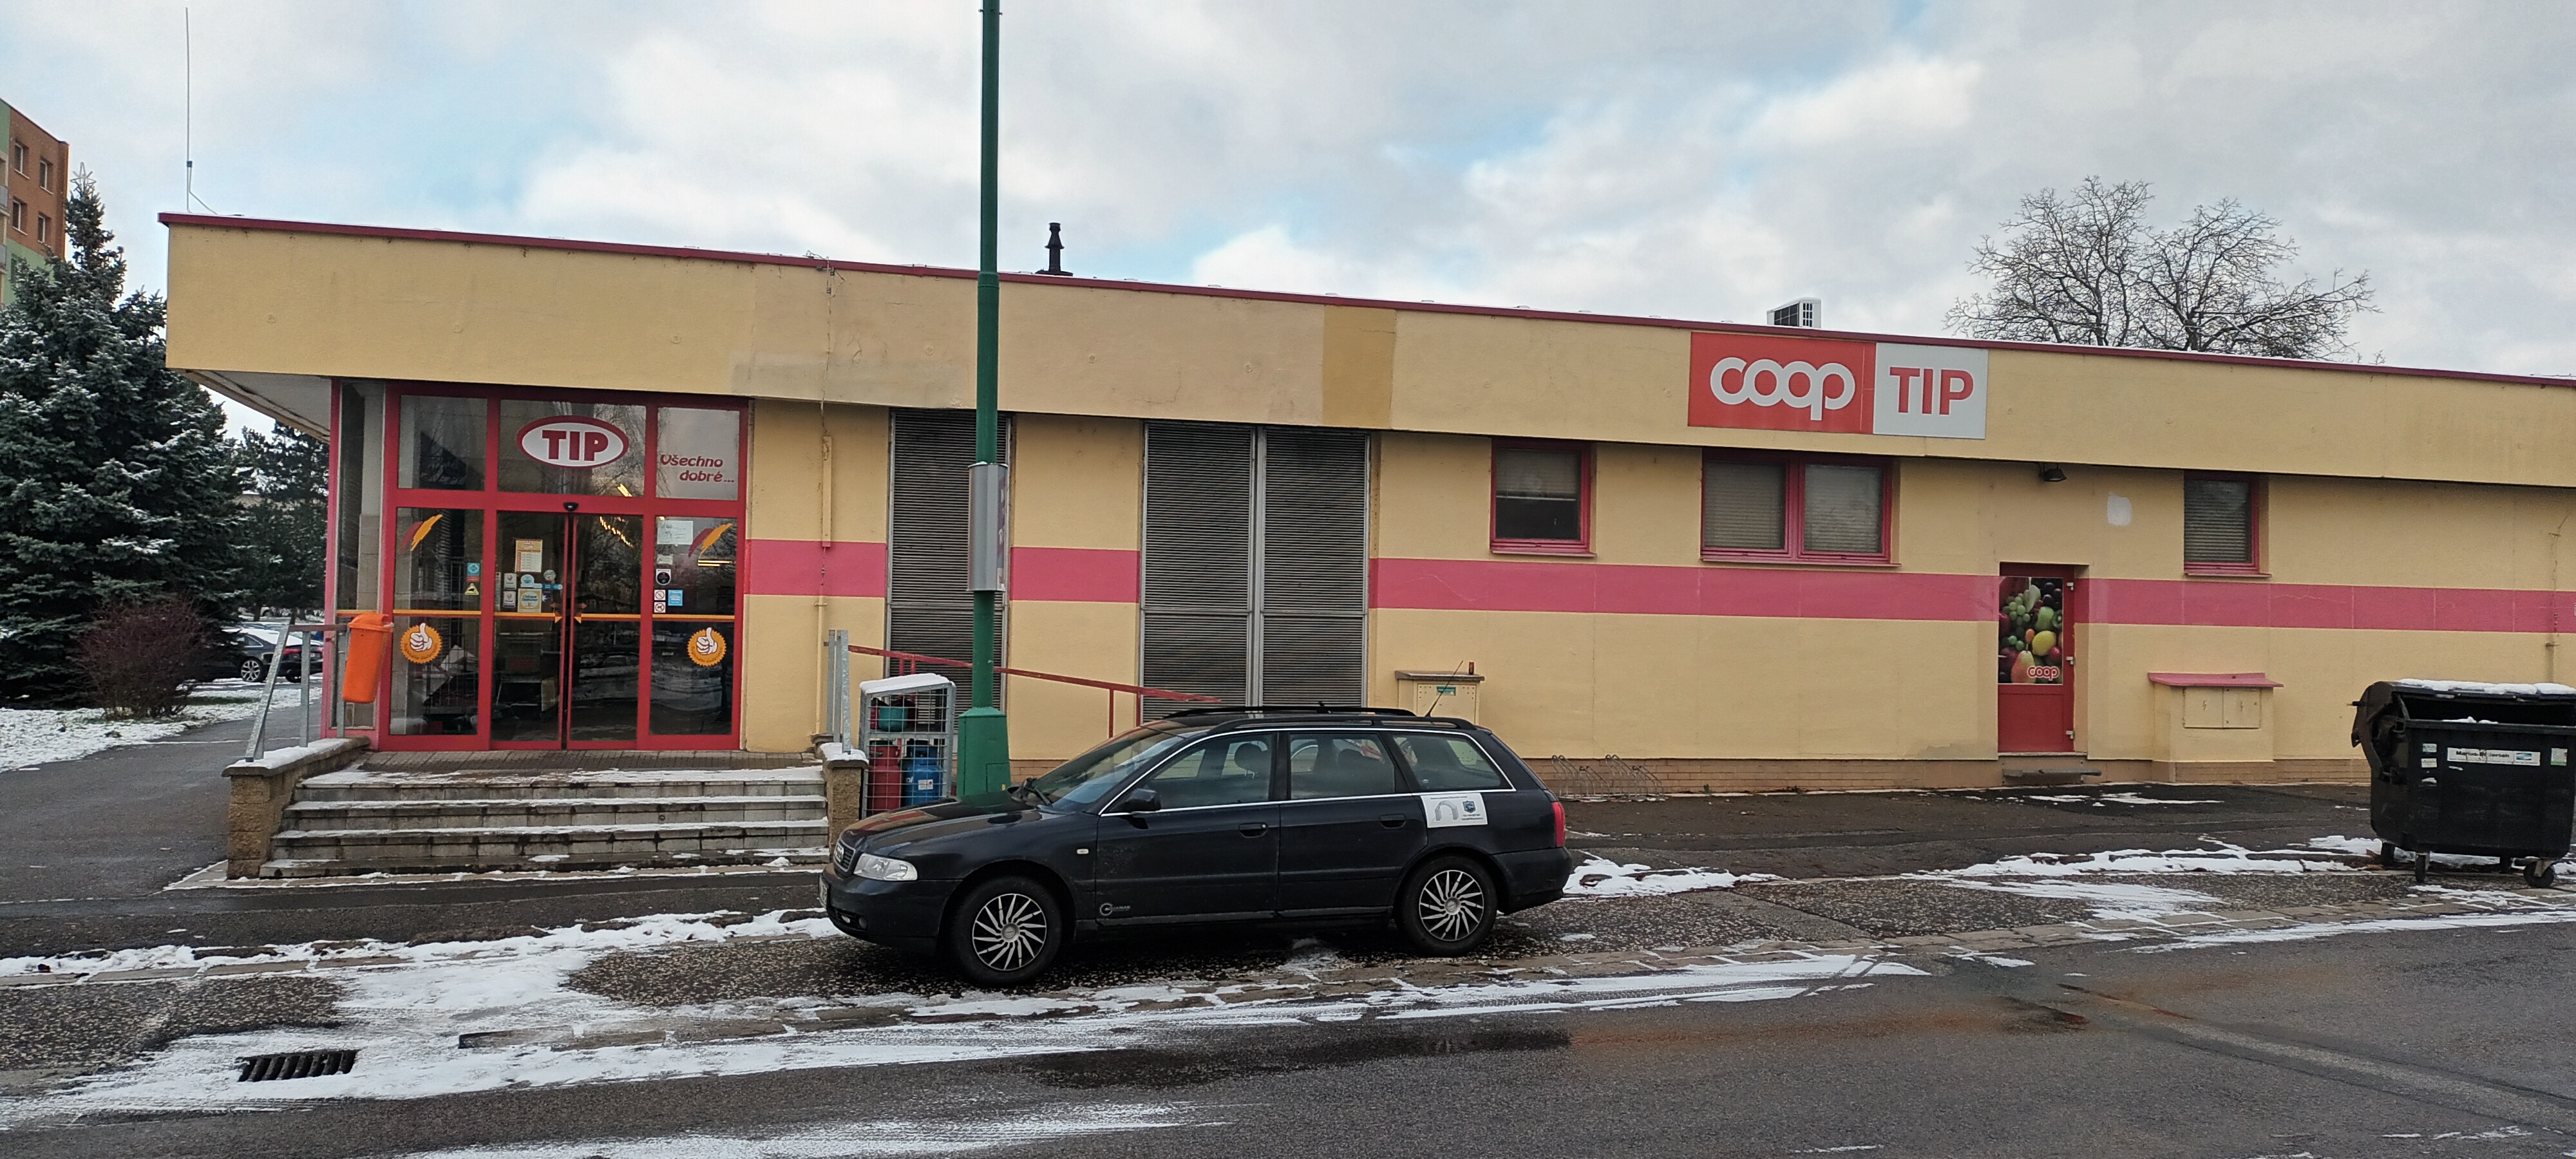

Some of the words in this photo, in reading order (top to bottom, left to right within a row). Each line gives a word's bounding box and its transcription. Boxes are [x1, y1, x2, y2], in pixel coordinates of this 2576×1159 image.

[1710, 357, 1856, 421] coop
[1889, 366, 1974, 416] TIP
[542, 429, 609, 462] TIP
[660, 454, 723, 467] Všechno
[2027, 666, 2060, 681] coop
